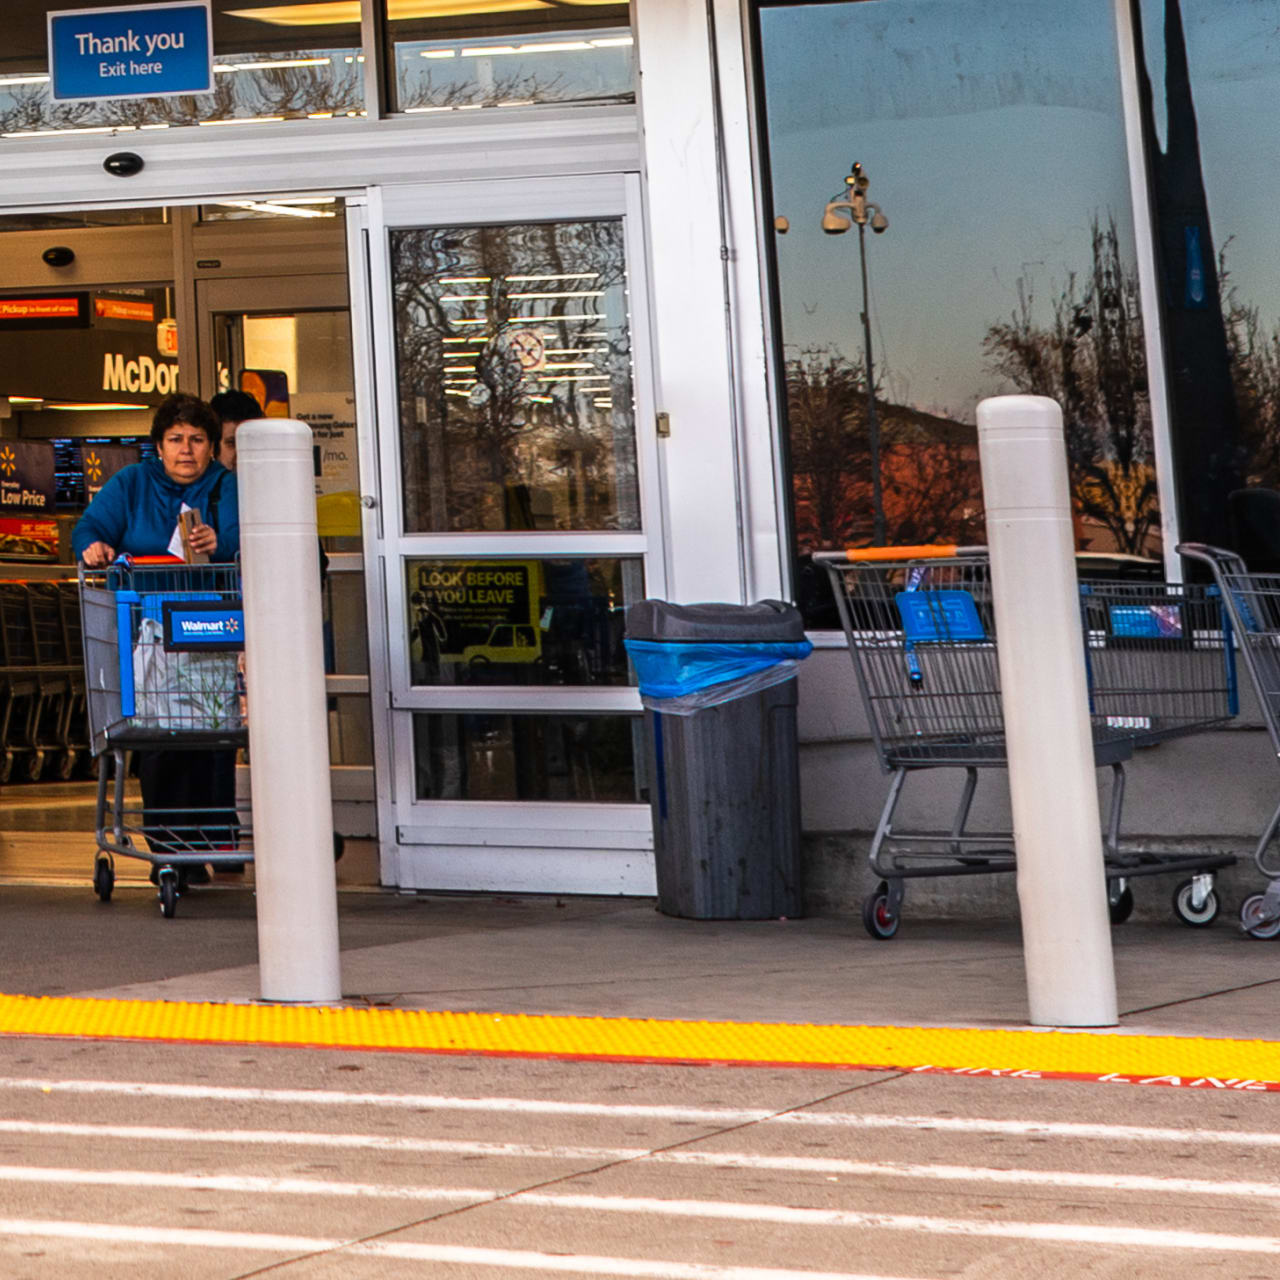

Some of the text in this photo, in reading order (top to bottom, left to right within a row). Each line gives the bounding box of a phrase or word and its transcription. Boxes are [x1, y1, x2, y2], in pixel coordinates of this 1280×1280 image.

[74, 29, 185, 57] Thank you
[99, 60, 163, 78] Exit here
[2, 304, 28, 315] Pickup
[1, 488, 46, 507] Low Price
[421, 571, 524, 587] LOOK BEFORE
[435, 589, 515, 604] YOU LEAVE
[181, 620, 224, 631] Walmart
